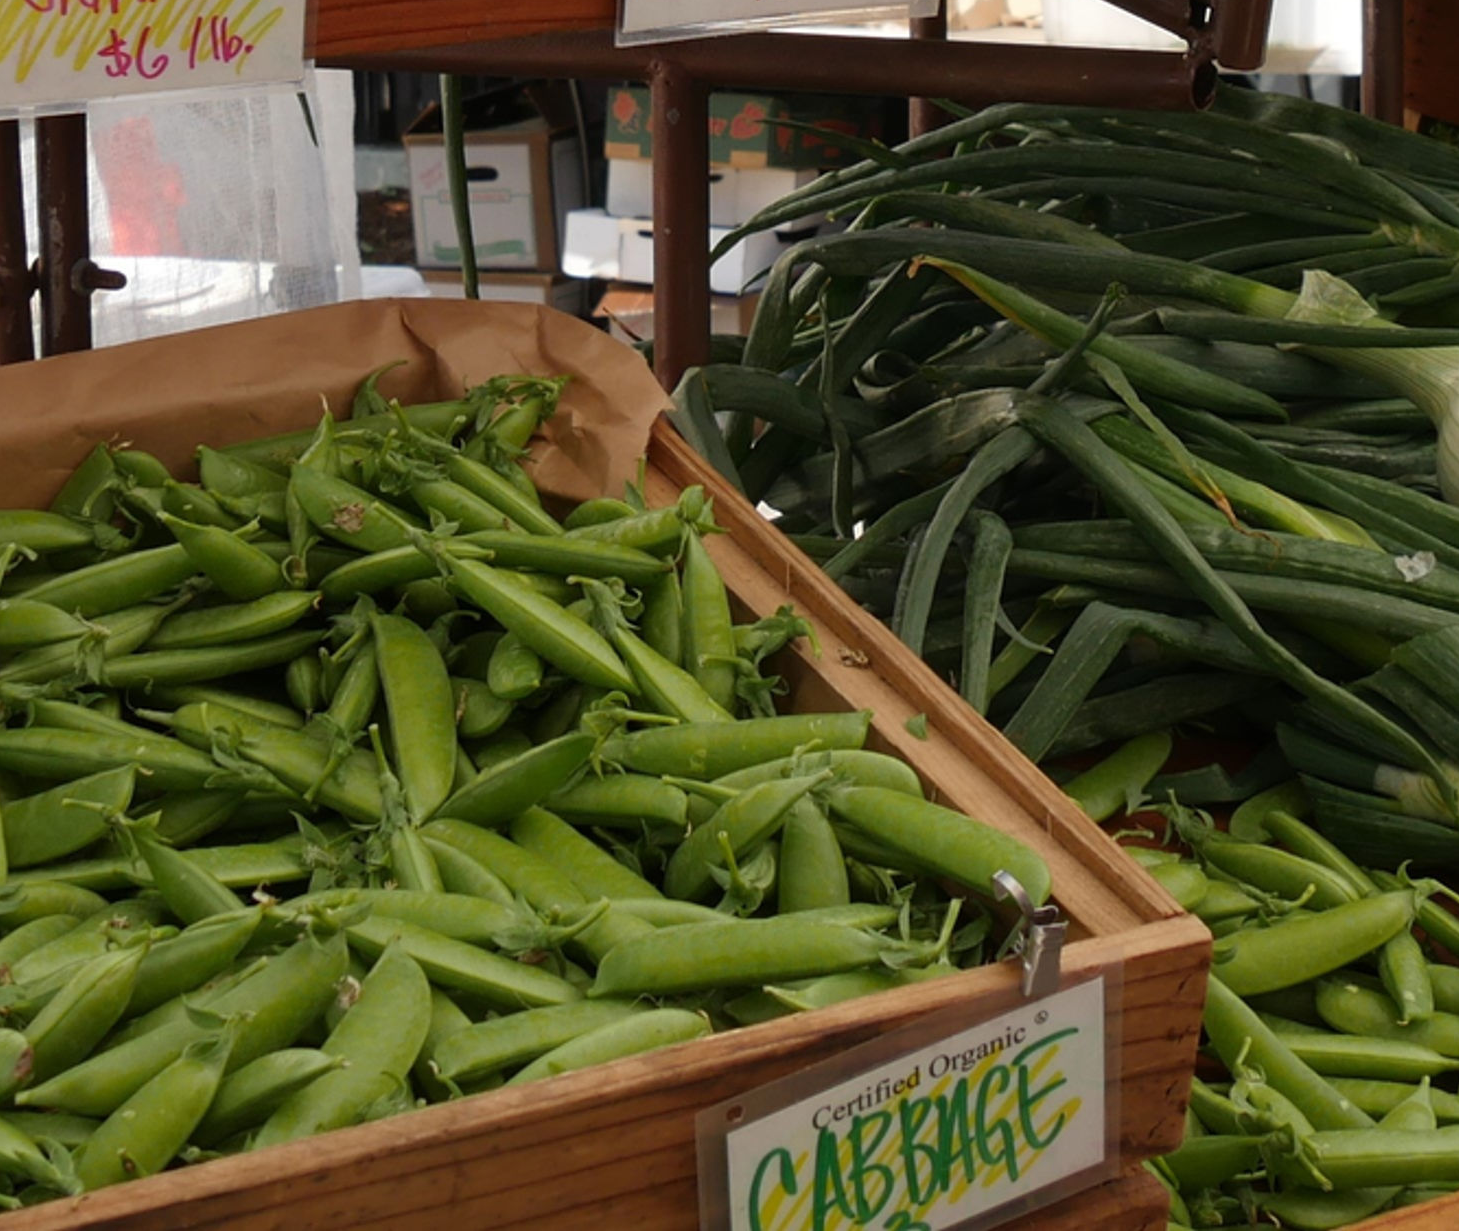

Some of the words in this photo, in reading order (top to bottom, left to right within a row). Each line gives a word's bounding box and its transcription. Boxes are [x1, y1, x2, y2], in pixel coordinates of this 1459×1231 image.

[748, 1027, 1080, 1231] CABBAGE
[812, 1065, 921, 1130] Certified
[929, 1025, 1026, 1078] Organic
